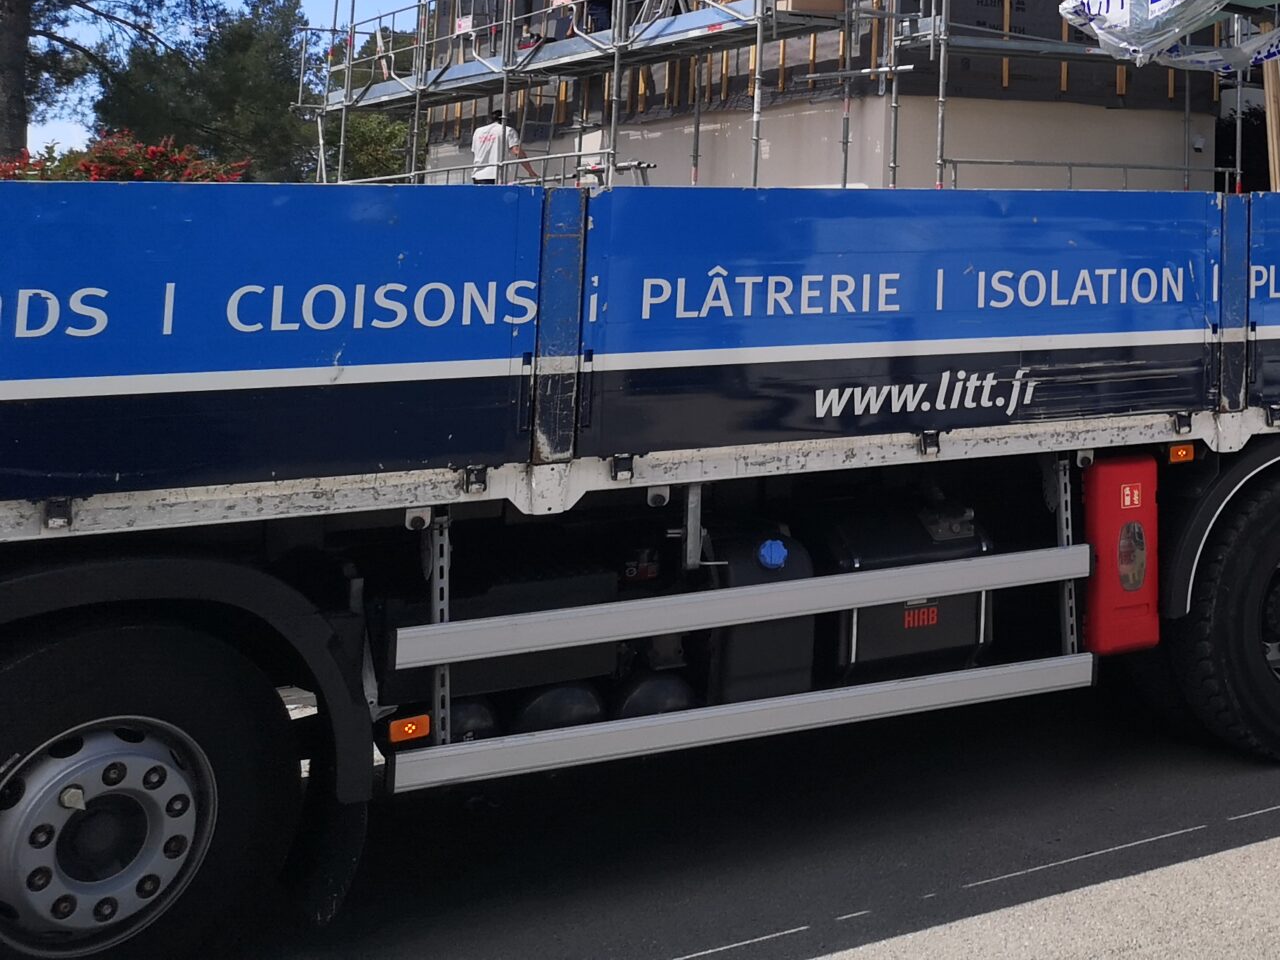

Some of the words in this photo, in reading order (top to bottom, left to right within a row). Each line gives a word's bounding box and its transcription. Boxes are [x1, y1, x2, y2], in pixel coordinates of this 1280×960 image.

[0, 287, 109, 338] DS
[226, 280, 538, 333] CLOISONS
[641, 265, 900, 321] PLÂTRERIE
[977, 267, 1185, 310] ISOLATION
[904, 607, 938, 629] HIAB
